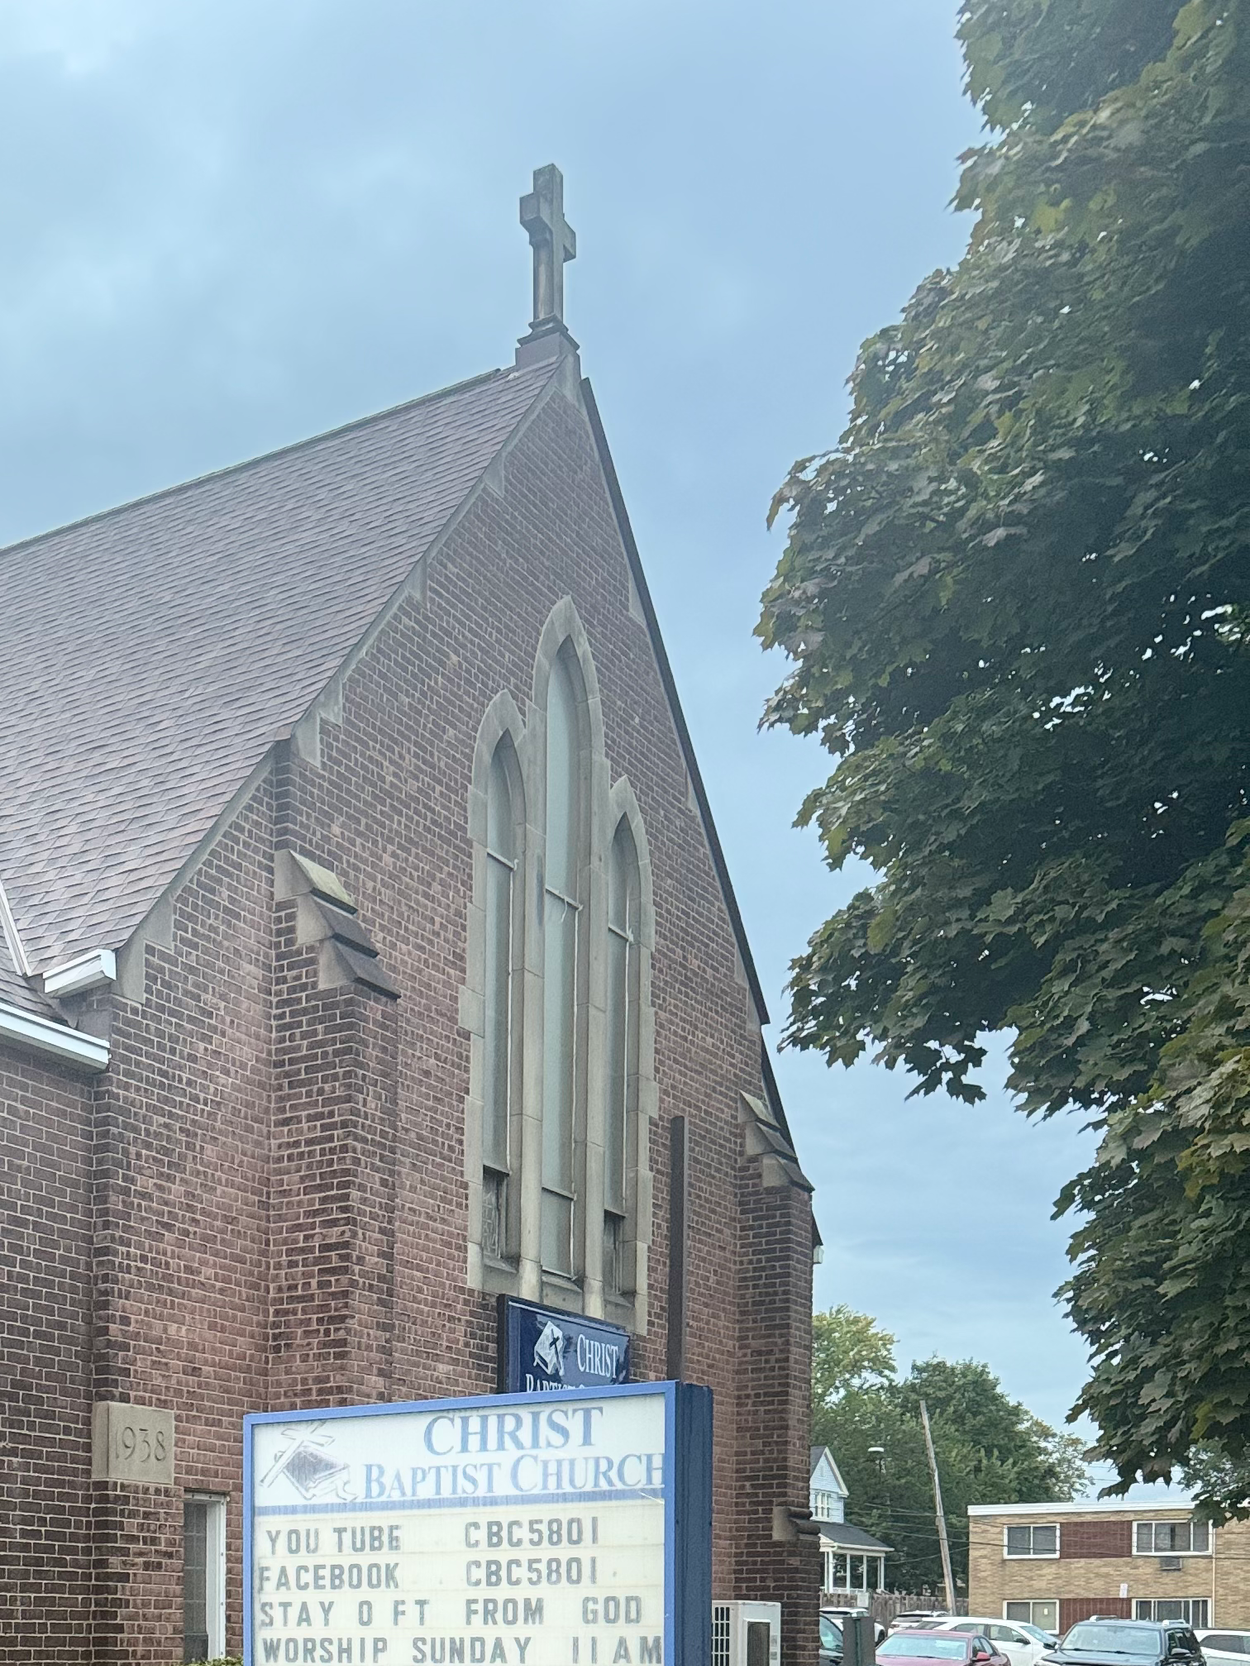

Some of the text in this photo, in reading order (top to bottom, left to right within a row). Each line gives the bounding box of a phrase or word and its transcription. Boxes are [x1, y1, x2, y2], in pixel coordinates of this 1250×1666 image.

[577, 1333, 619, 1379] CHRIST
[115, 1426, 168, 1463] 1938
[423, 1406, 603, 1456] CHRIST
[363, 1452, 665, 1501] BAPTIST CHURCH
[266, 1516, 599, 1556] YOU TUBE CBC5801
[258, 1556, 598, 1592] FACEBOOK CBC5801
[260, 1600, 335, 1628] STAY
[465, 1597, 545, 1626] FROM
[582, 1595, 643, 1625] GOD
[262, 1637, 388, 1664] WORSHIP
[412, 1636, 532, 1664] SUNDAY
